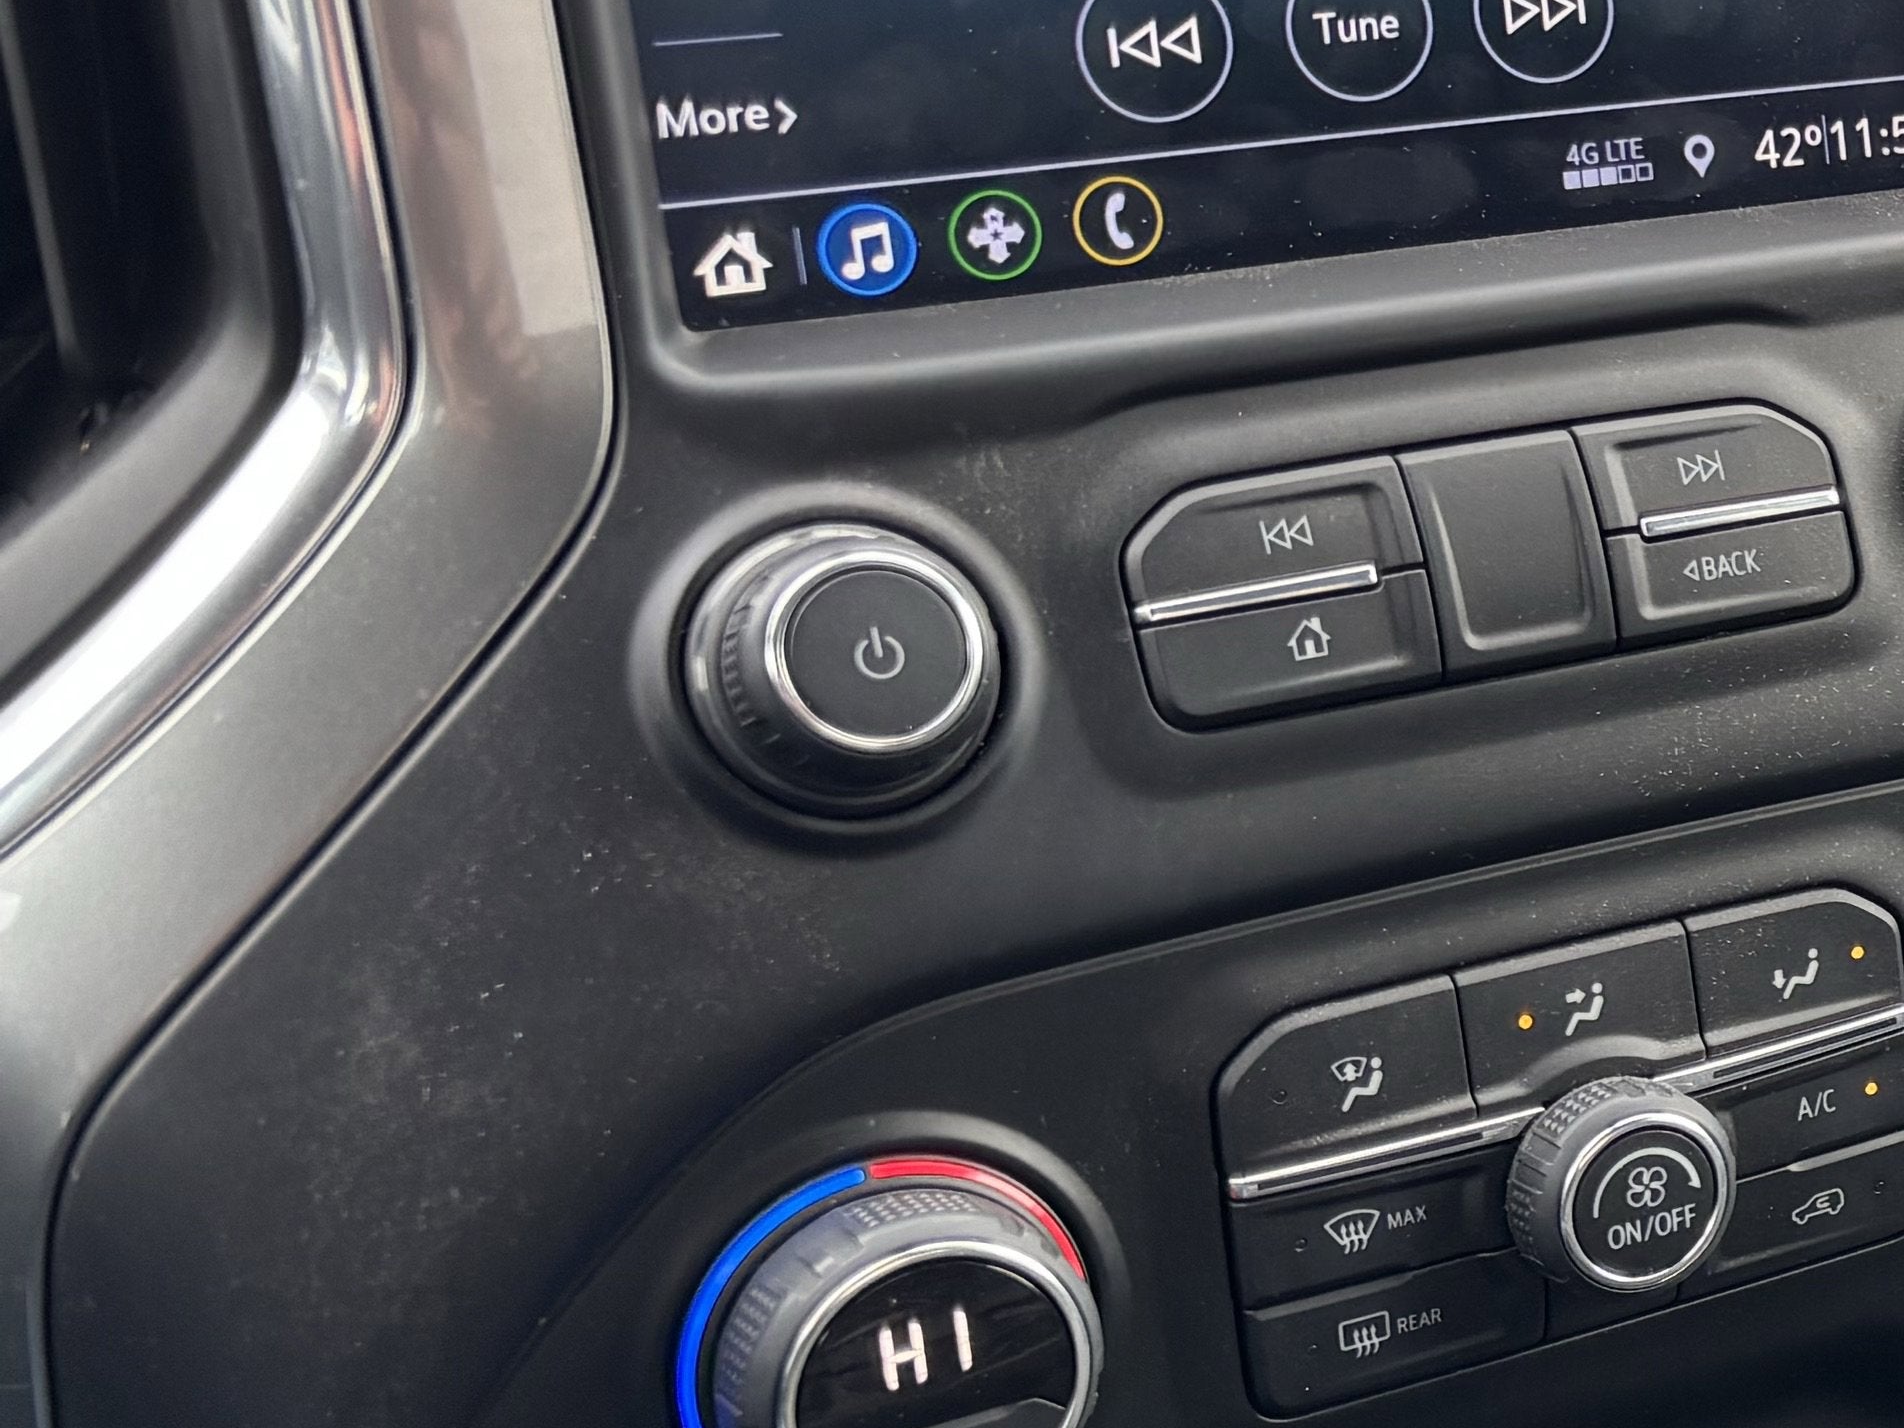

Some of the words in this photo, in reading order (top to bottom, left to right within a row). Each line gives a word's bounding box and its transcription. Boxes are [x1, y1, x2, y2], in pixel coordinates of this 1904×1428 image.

[1312, 9, 1401, 45] Tune
[656, 96, 771, 139] More
[1565, 141, 1599, 167] 4G
[1604, 137, 1646, 162] LTE
[1701, 548, 1762, 581] BACK
[1797, 1090, 1838, 1122] A/C
[1386, 1204, 1429, 1232] MAX
[1606, 1200, 1699, 1252] ON/OFF
[1396, 1306, 1443, 1335] REAR
[878, 1305, 974, 1393] HI
